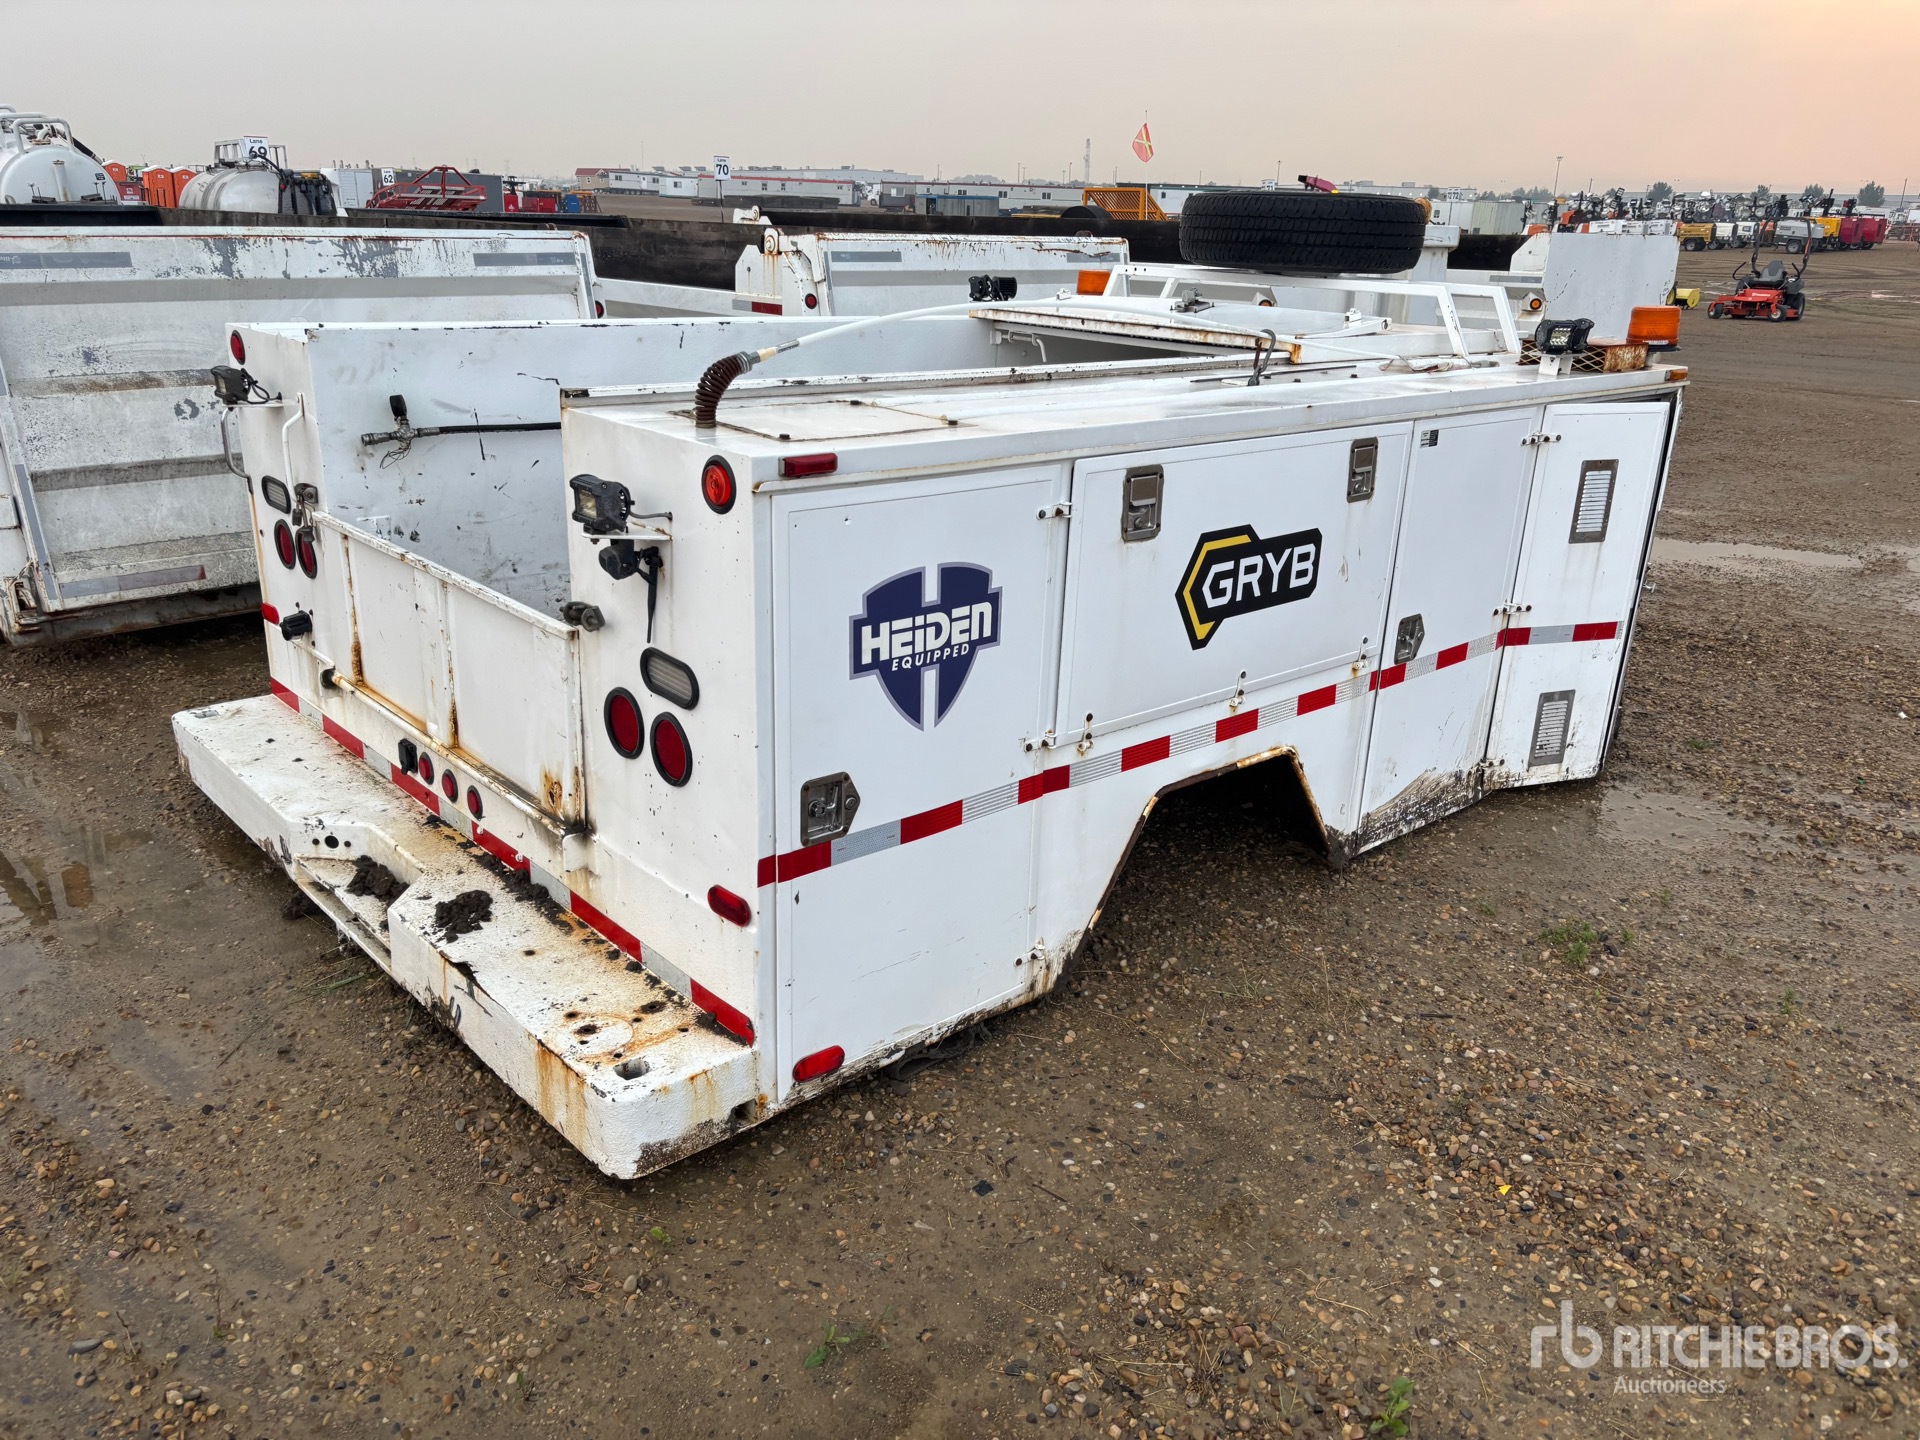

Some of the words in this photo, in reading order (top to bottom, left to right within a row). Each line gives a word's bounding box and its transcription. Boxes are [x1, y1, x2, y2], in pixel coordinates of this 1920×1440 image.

[383, 174, 394, 184] 62
[715, 163, 729, 176] 70
[1202, 543, 1316, 609] GRYB
[861, 601, 993, 666] HEIDEN
[891, 643, 970, 672] EQUIPPED
